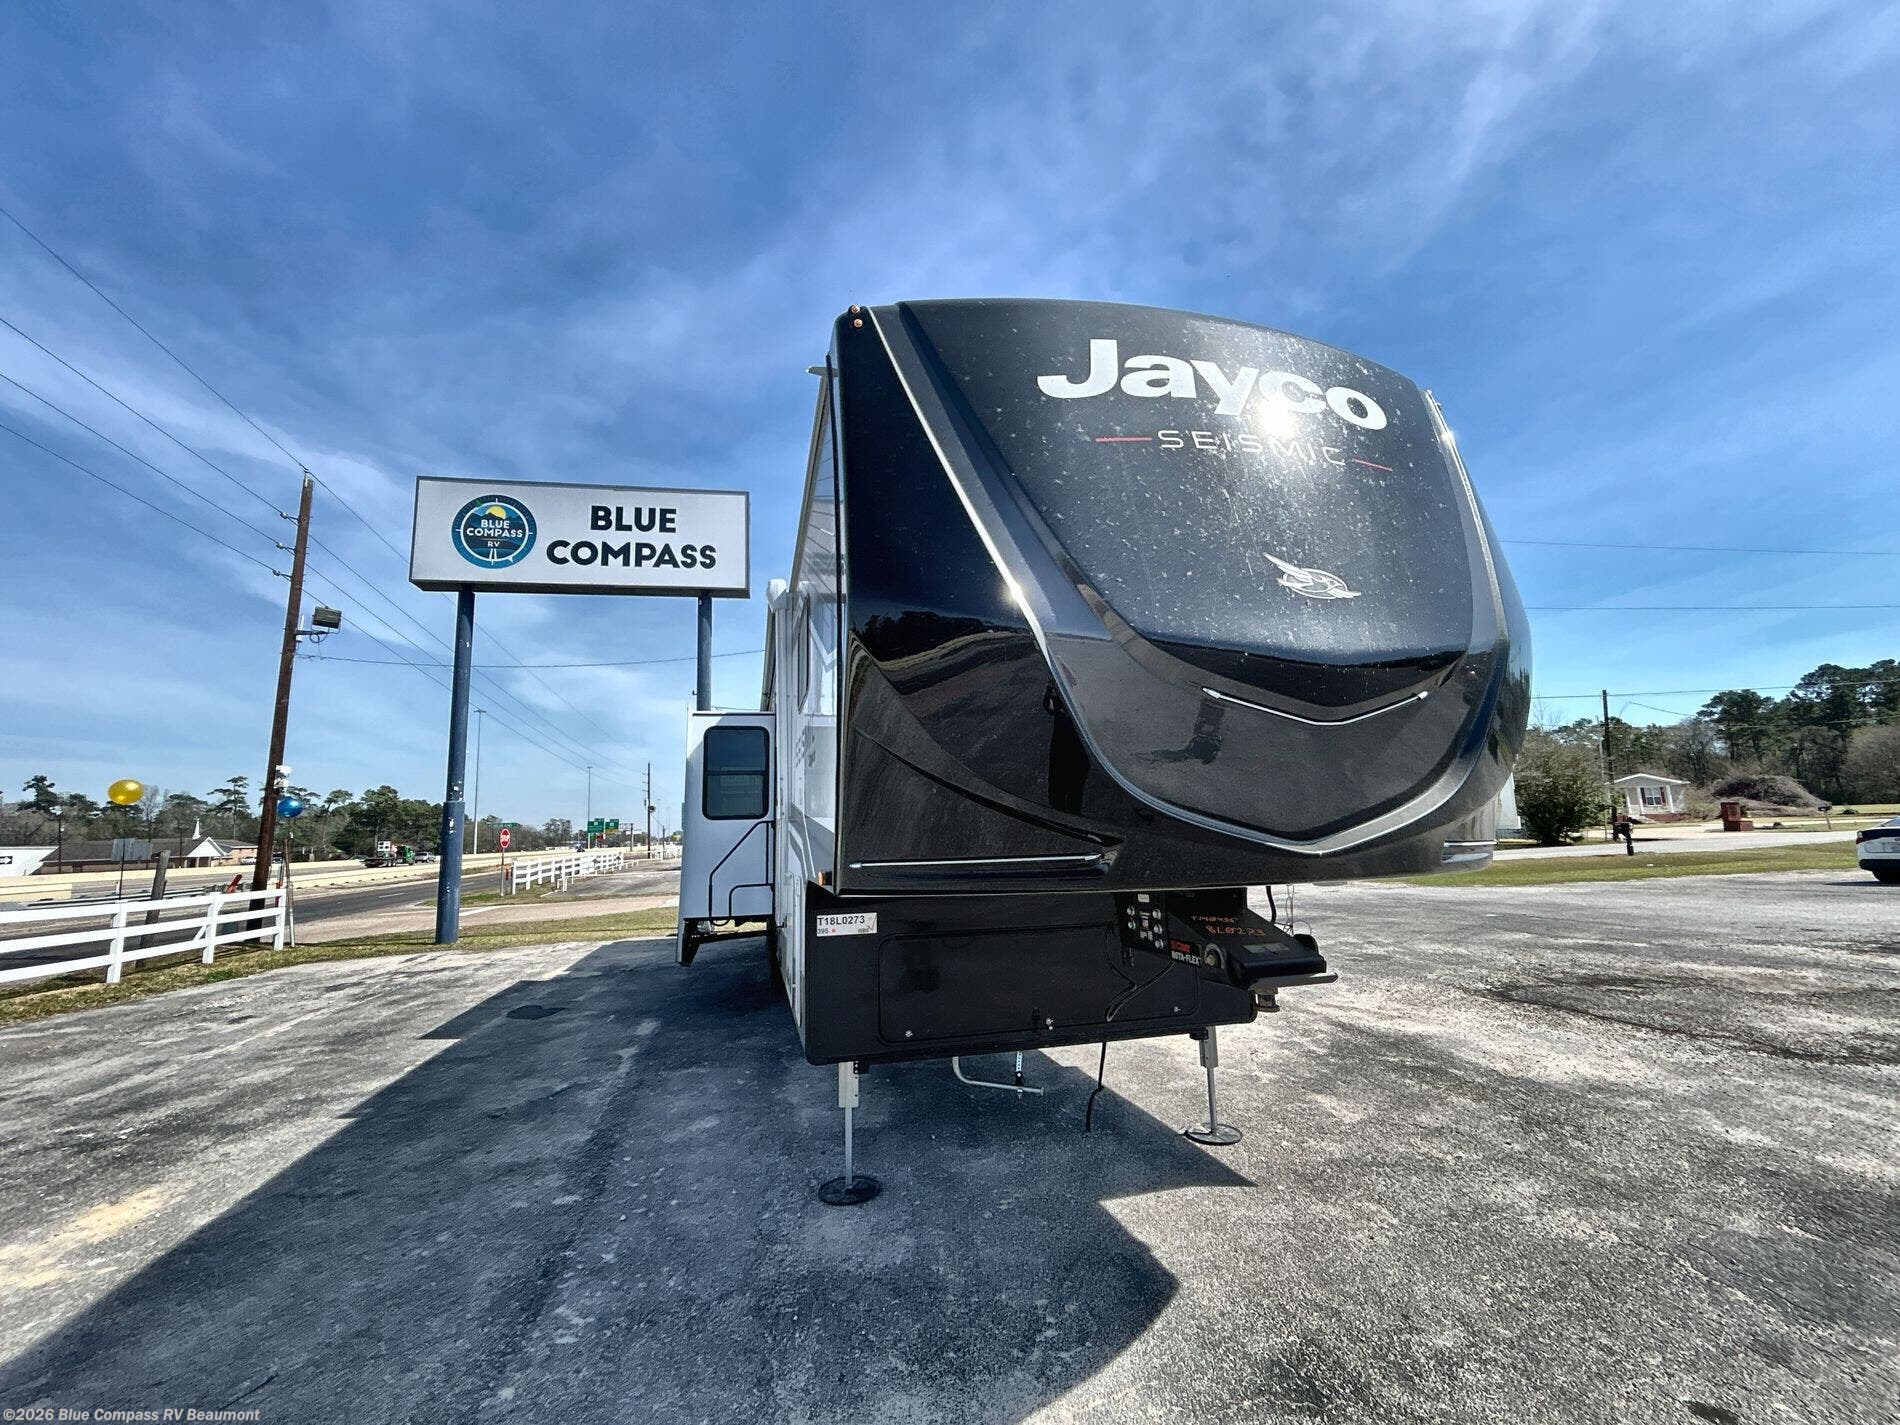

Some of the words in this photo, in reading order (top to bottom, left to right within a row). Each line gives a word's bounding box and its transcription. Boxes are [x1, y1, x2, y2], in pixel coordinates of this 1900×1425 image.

[1036, 338, 1387, 431] Jayco
[1157, 430, 1346, 466] SEISMIC
[466, 528, 523, 538] COMPASS
[481, 519, 510, 529] BLUE
[590, 505, 677, 533] BLUE
[546, 539, 717, 570] COMPASS
[817, 915, 865, 926] T18L0273
